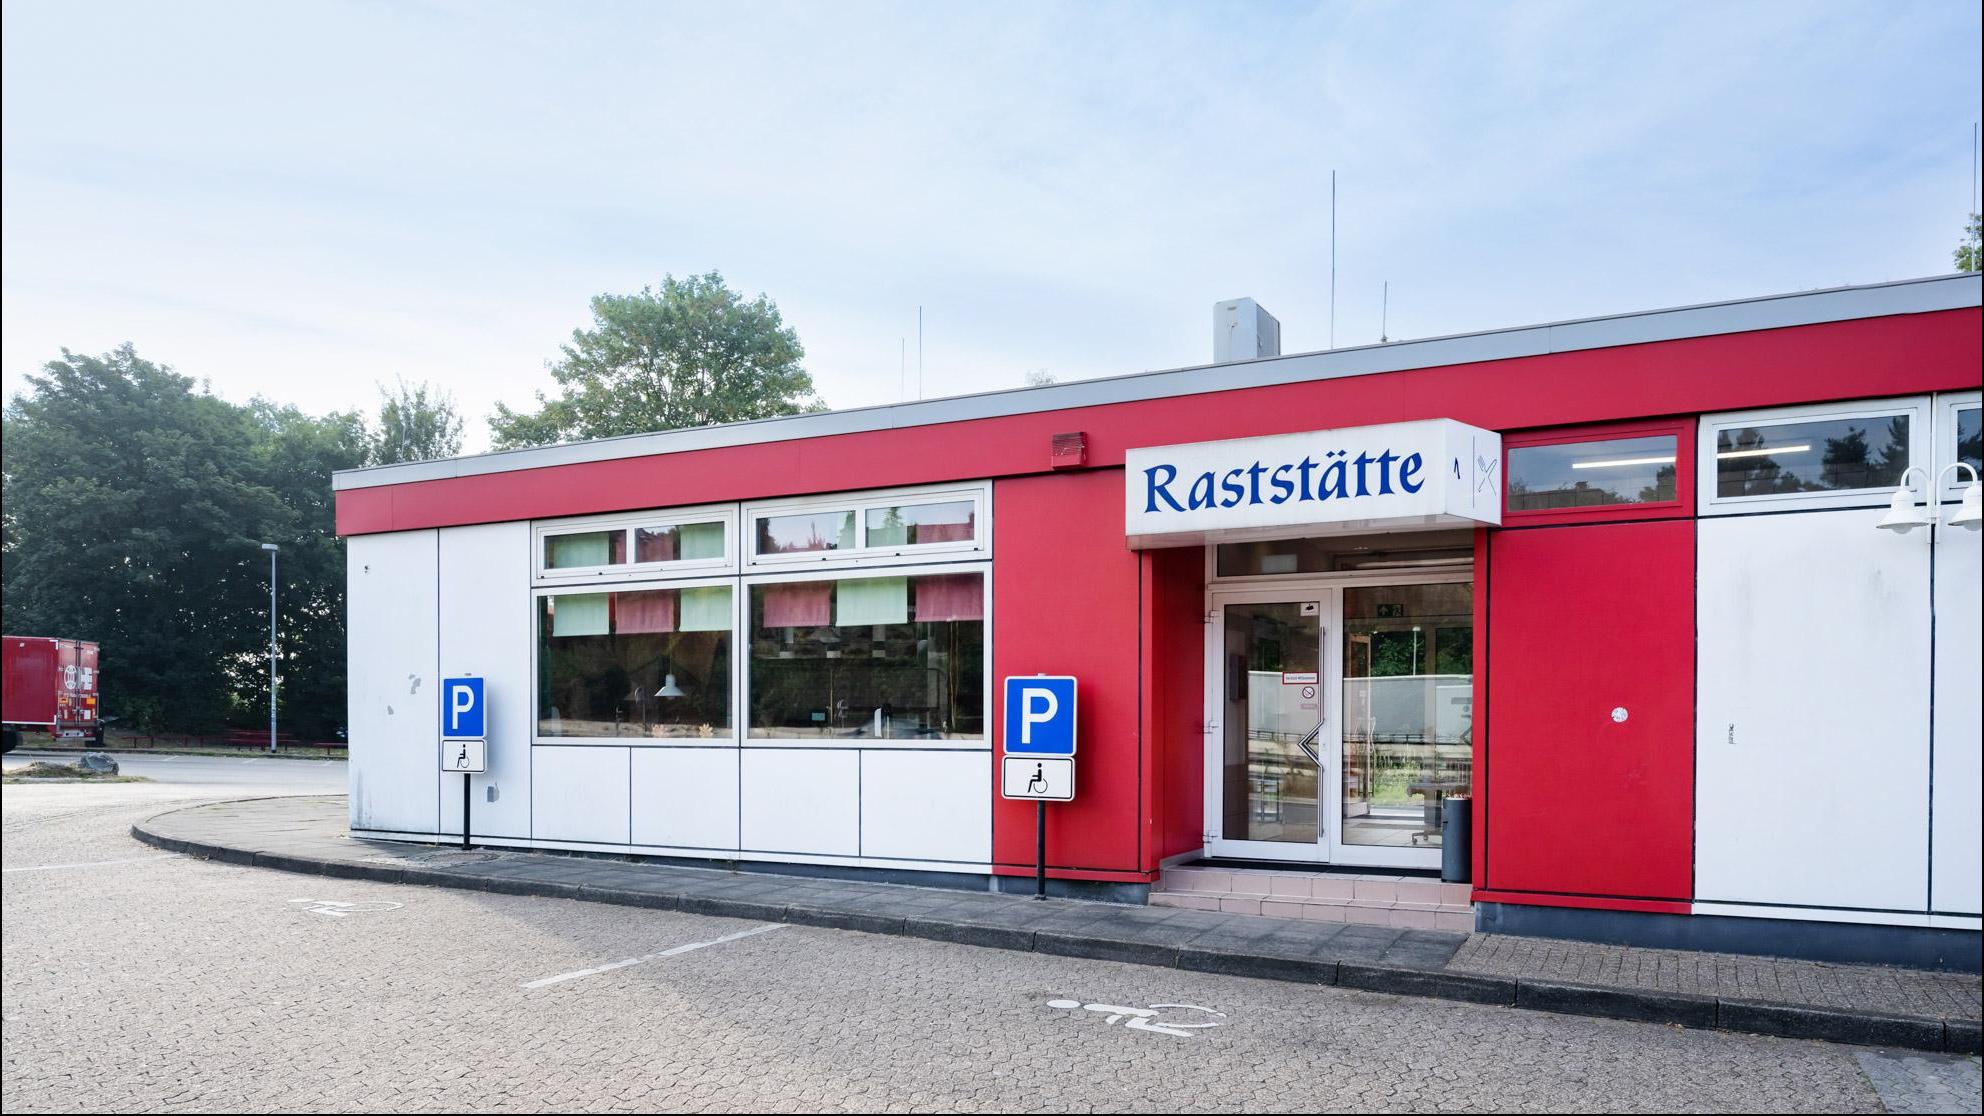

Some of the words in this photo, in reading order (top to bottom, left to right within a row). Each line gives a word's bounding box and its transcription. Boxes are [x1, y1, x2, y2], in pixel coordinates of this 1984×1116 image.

[1143, 447, 1426, 513] Raststätte
[452, 685, 475, 730] P
[1021, 688, 1059, 744] P
